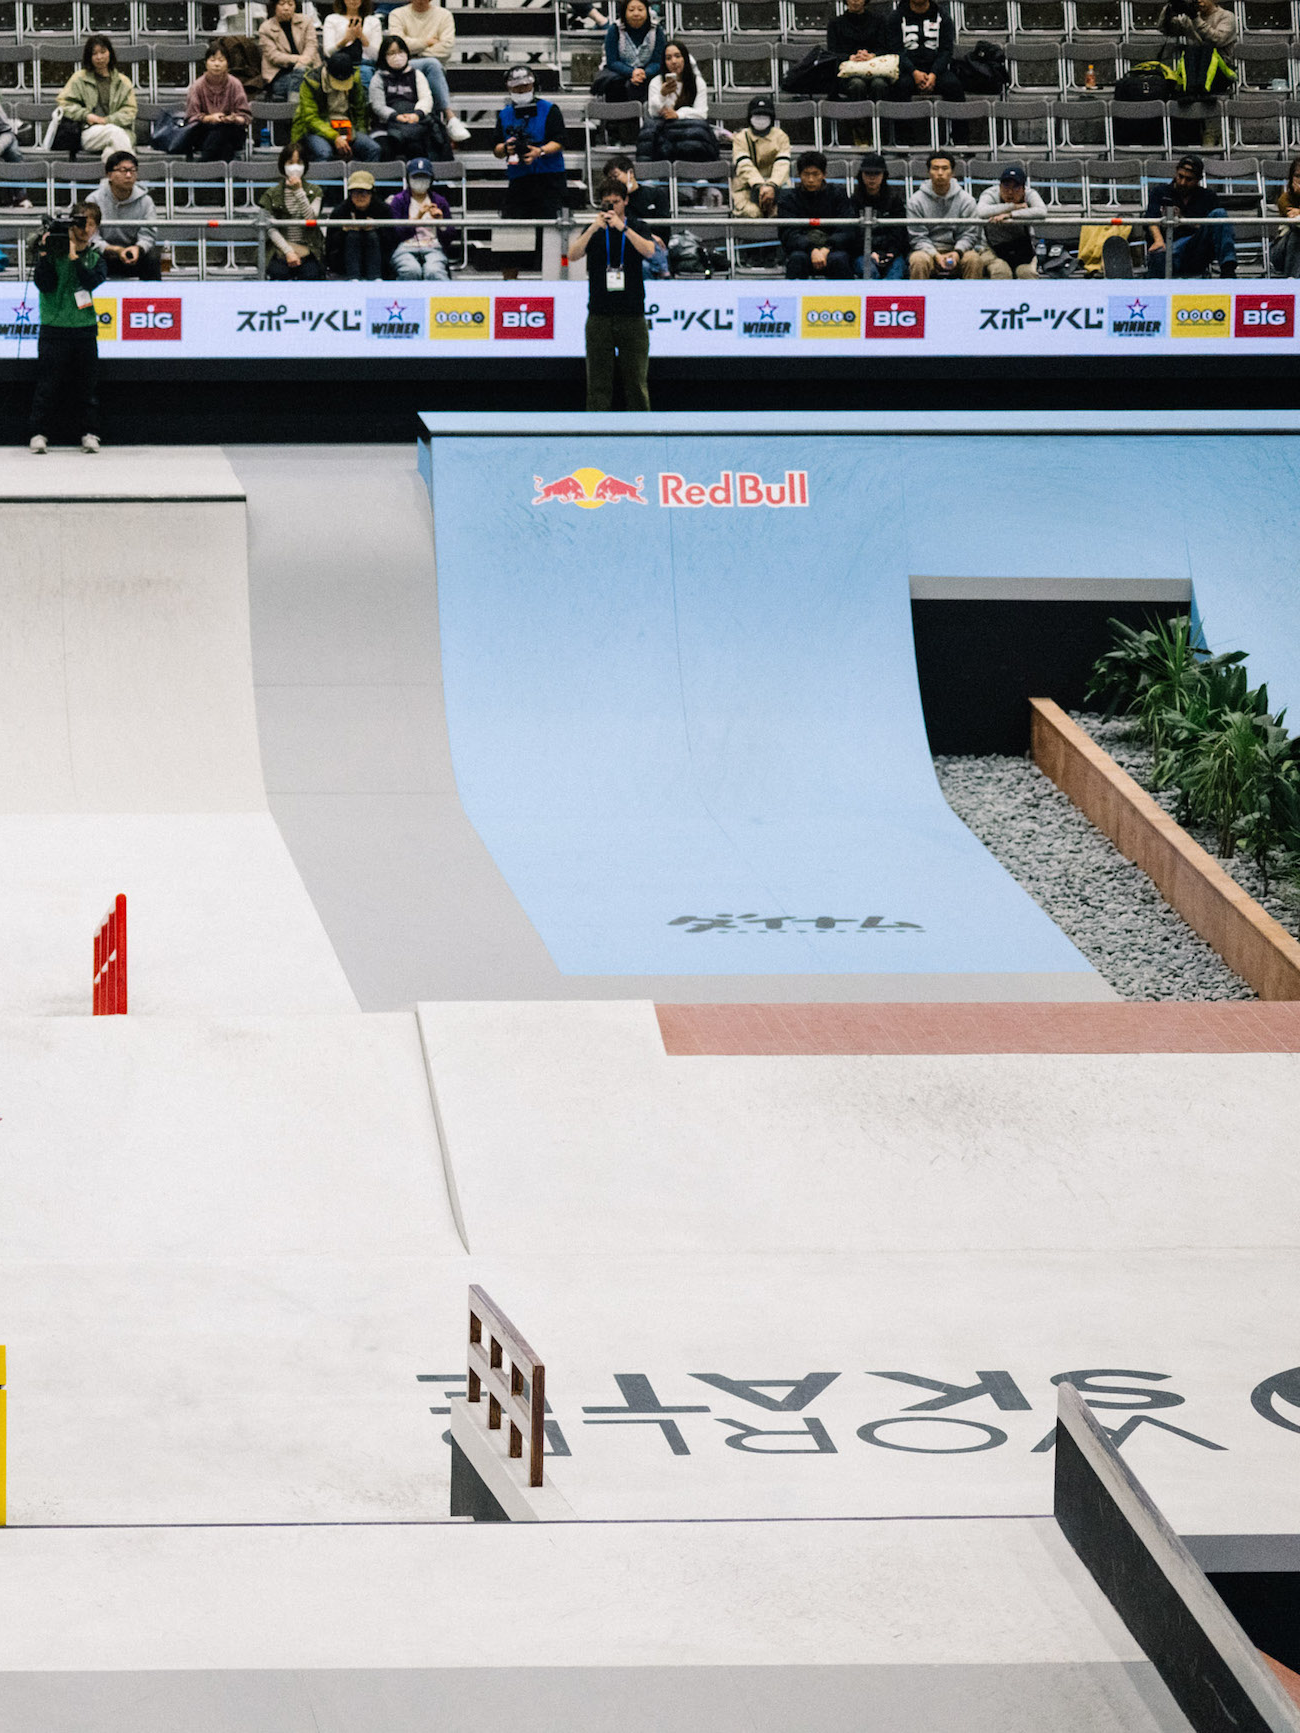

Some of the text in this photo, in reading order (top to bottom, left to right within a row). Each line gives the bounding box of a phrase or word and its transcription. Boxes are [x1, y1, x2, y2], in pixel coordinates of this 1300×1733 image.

[236, 305, 361, 332] スポーツくじ
[979, 303, 1104, 330] スポーツくじ
[1113, 320, 1161, 333] WINNER
[371, 322, 420, 335] WINNER
[743, 322, 792, 334] WINNER
[660, 470, 808, 506] Red Bull
[666, 913, 924, 933] ダイナム
